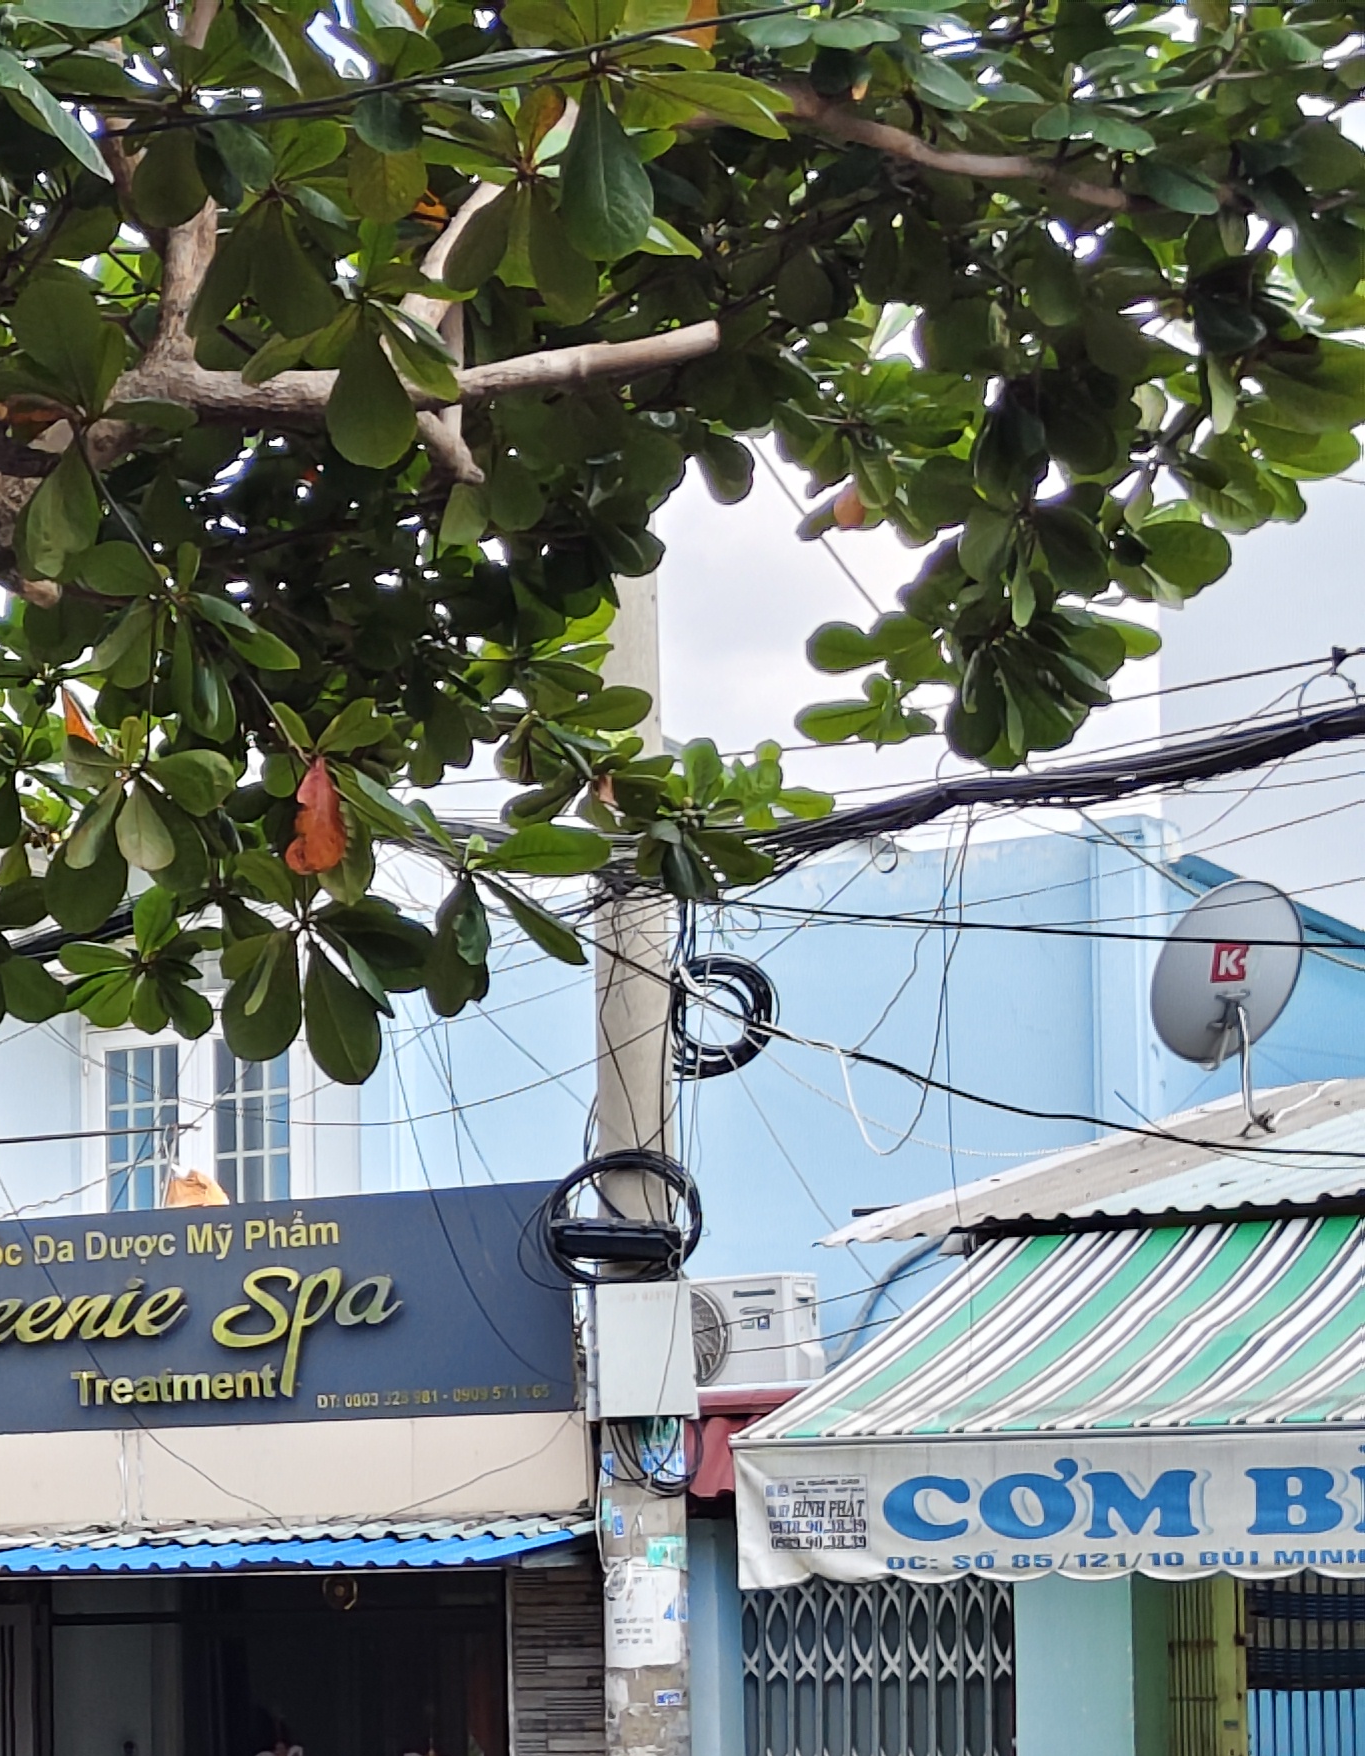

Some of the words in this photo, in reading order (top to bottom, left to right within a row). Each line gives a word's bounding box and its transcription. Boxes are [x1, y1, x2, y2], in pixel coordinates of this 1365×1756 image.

[33, 1233, 75, 1265] Da
[84, 1231, 176, 1265] Dược
[186, 1222, 234, 1260] Mỹ
[243, 1209, 341, 1251] Phẩm
[211, 1264, 405, 1398] Spa
[70, 1362, 278, 1406] Treatment
[882, 1457, 1201, 1542] CƠM
[952, 1549, 999, 1570] SỐ
[1010, 1551, 1185, 1570] 85/121/10
[1198, 1547, 1259, 1567] BÙI
